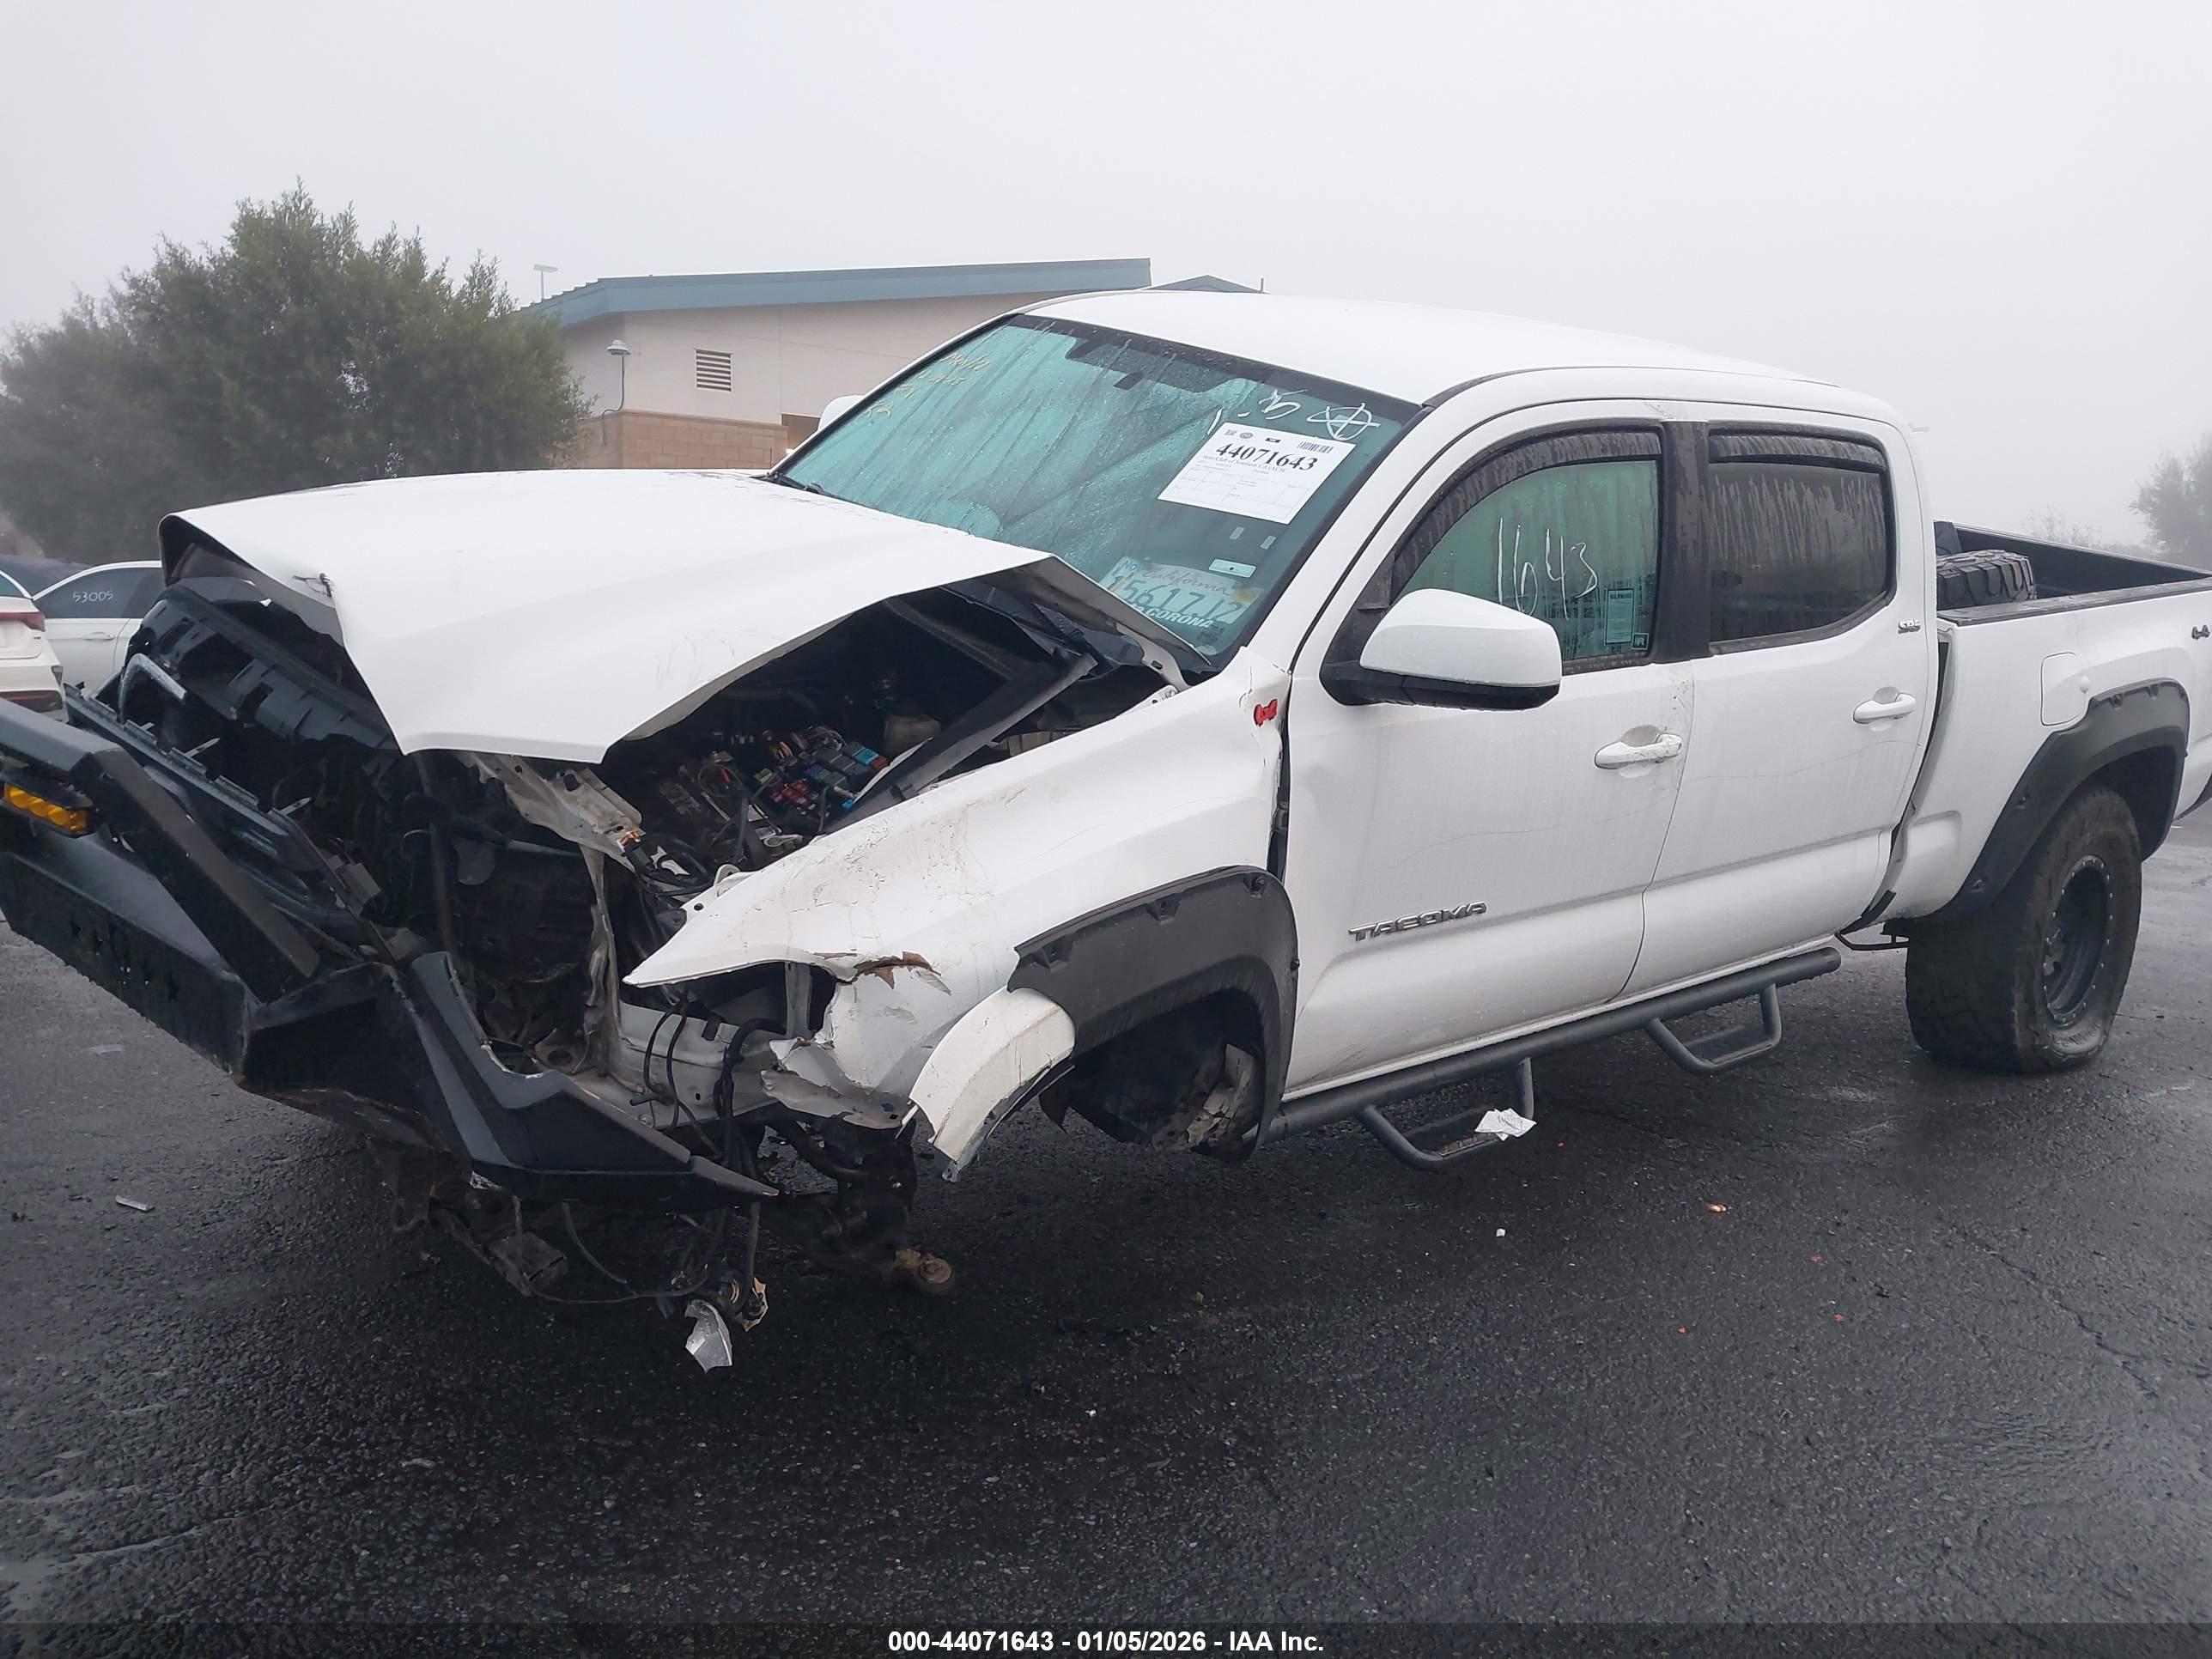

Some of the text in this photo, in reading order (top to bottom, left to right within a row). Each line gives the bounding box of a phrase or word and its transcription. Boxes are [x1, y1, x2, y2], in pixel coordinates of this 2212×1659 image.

[1215, 442, 1319, 471] 44071643
[1497, 517, 1598, 620] 1643
[1146, 607, 1215, 628] CORONA
[1348, 900, 1488, 942] TACOMA
